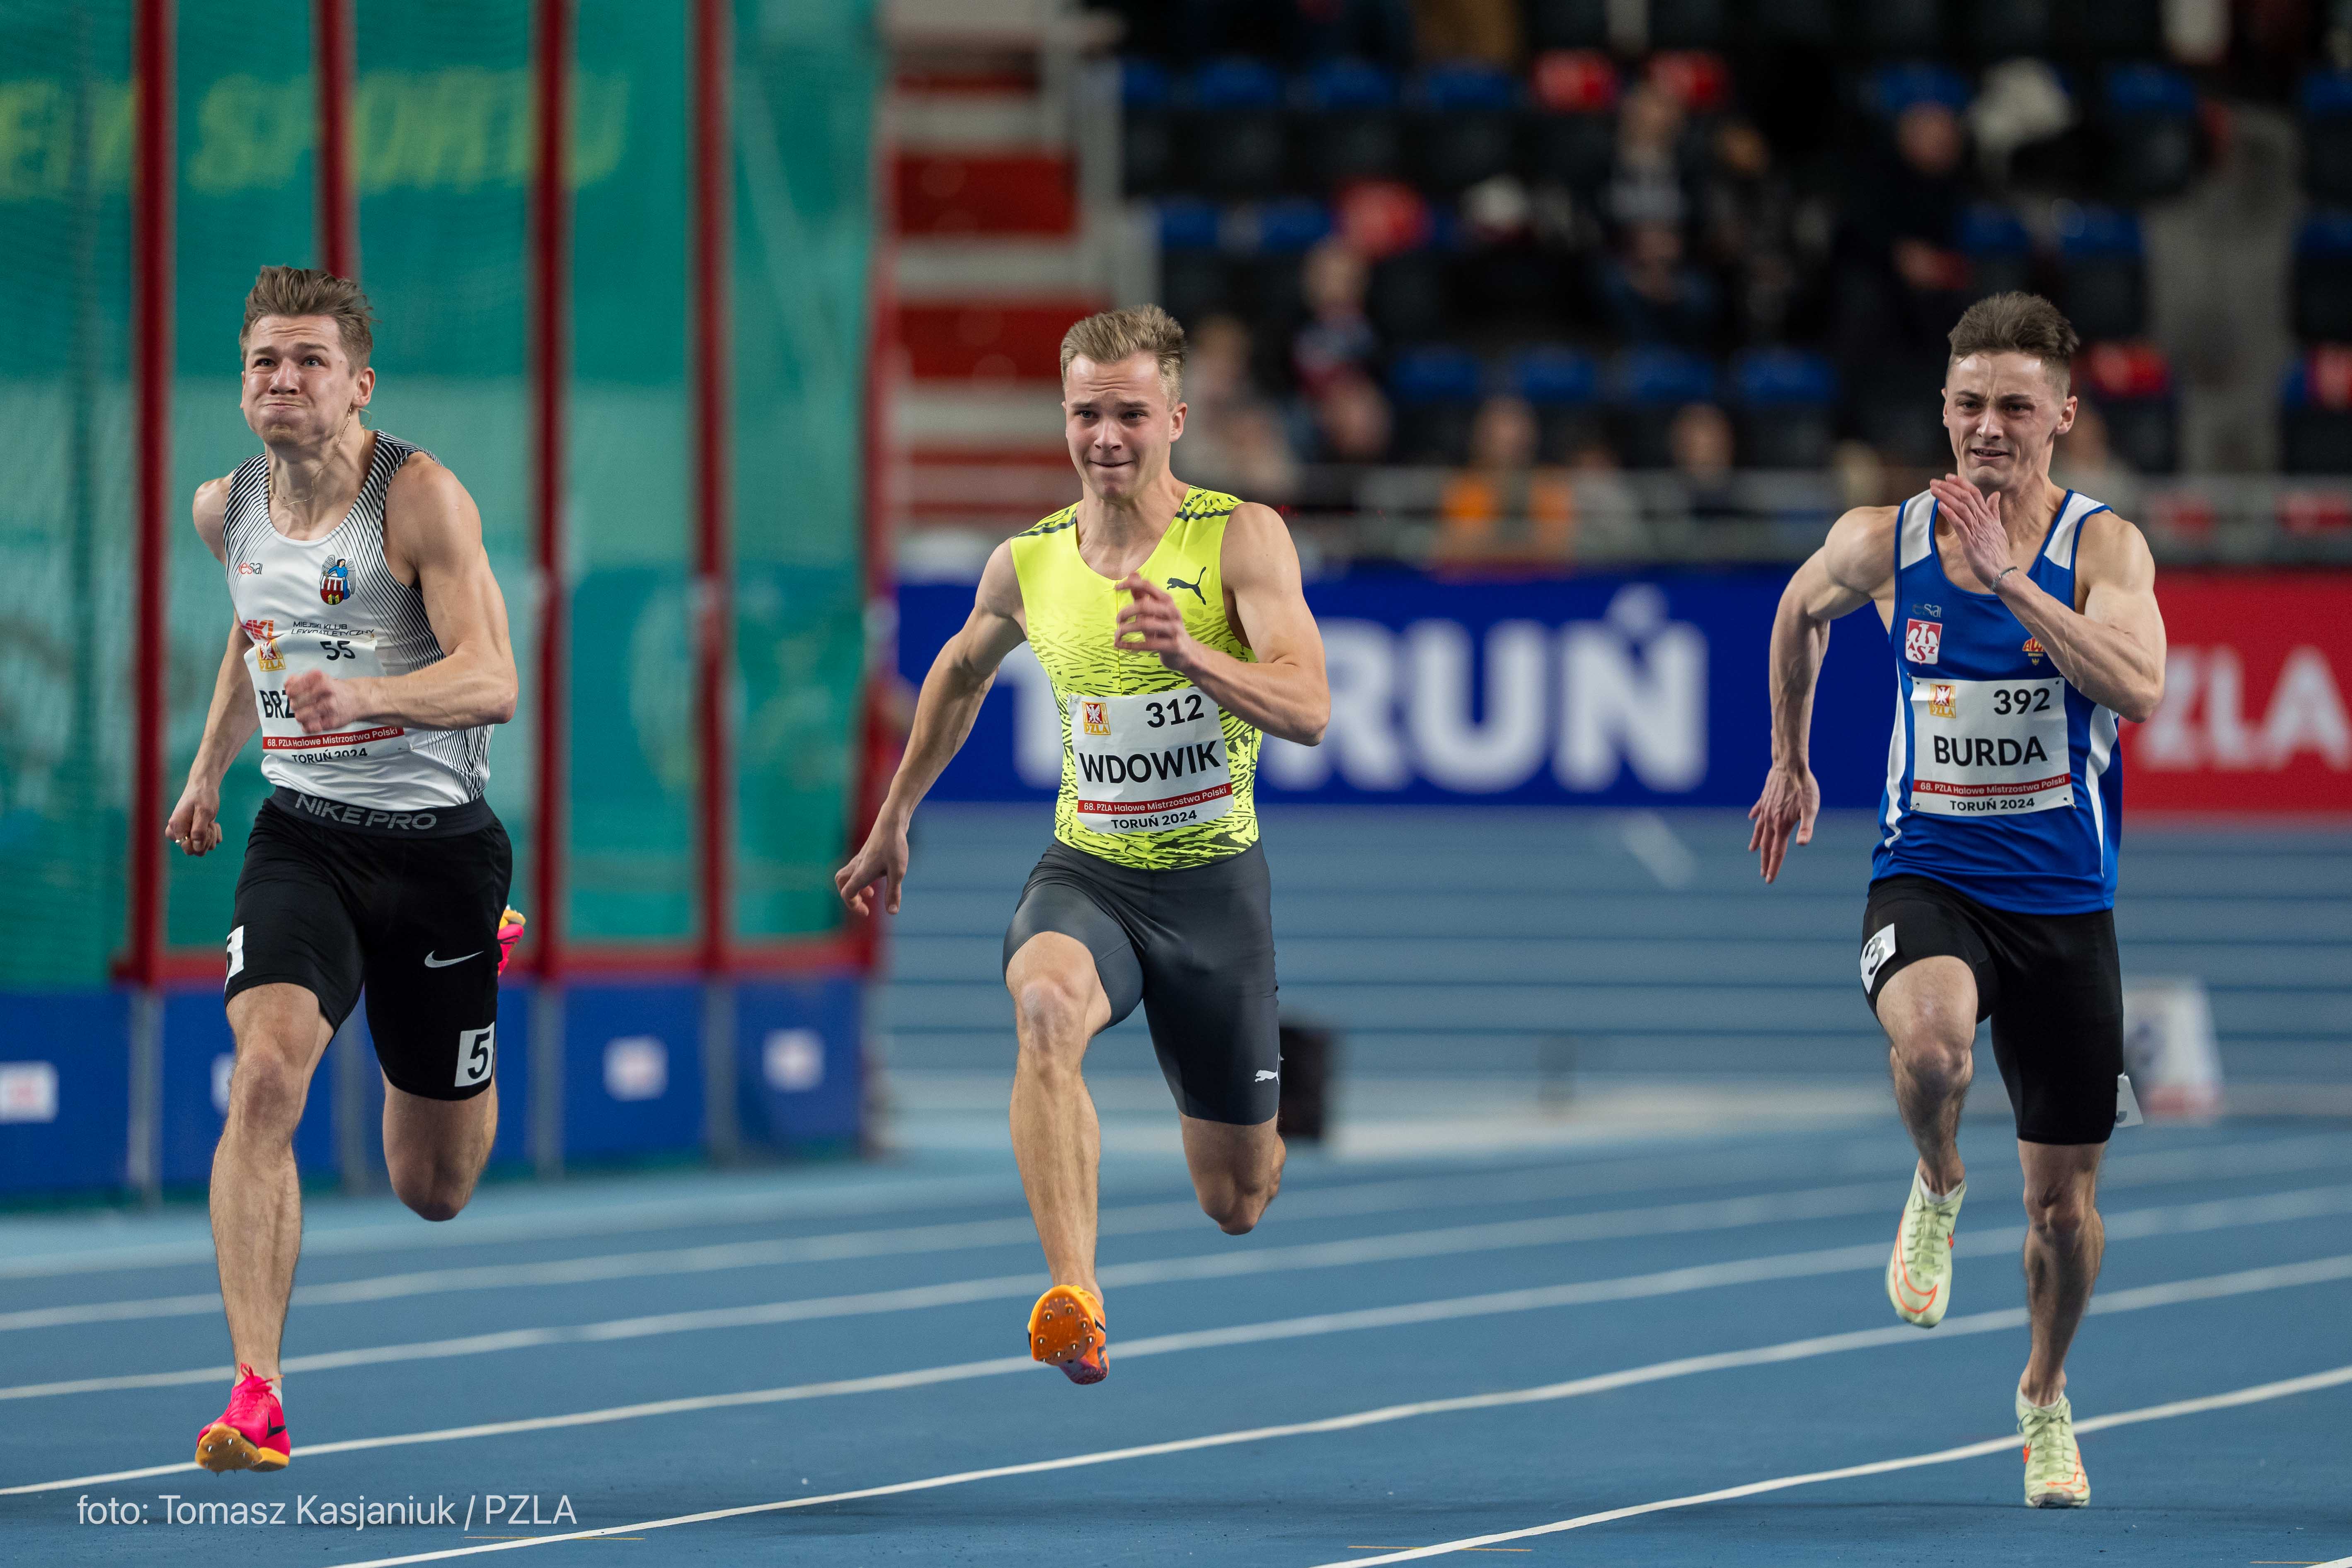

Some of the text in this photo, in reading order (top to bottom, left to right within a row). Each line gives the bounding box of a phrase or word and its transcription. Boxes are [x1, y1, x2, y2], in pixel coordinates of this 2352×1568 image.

[320, 640, 356, 661] 55
[997, 584, 1710, 794] TRUŃ
[1993, 687, 2050, 715] 392
[259, 690, 296, 719] BRZ
[1145, 694, 1204, 728] 312
[2120, 643, 2352, 773] ZLA
[267, 727, 398, 747] 68. PZLA Halowe Mistrzostwa Polski
[1085, 724, 1109, 734] PZLA
[291, 749, 333, 764] TORUŃ
[1078, 740, 1221, 784] WDOWIK
[1933, 734, 2048, 767] BURDA
[1084, 786, 1227, 812] 68. PZLA Halowe Mistrzostwa Polski
[1920, 777, 2066, 795] 68. PZLA Halowe Mistrzostwa Polski
[295, 793, 437, 830] NIKE PRO
[1950, 797, 2035, 811] TORUŃ 2024
[1111, 809, 1197, 829] TORUŃ 2024
[467, 1030, 491, 1080] 5
